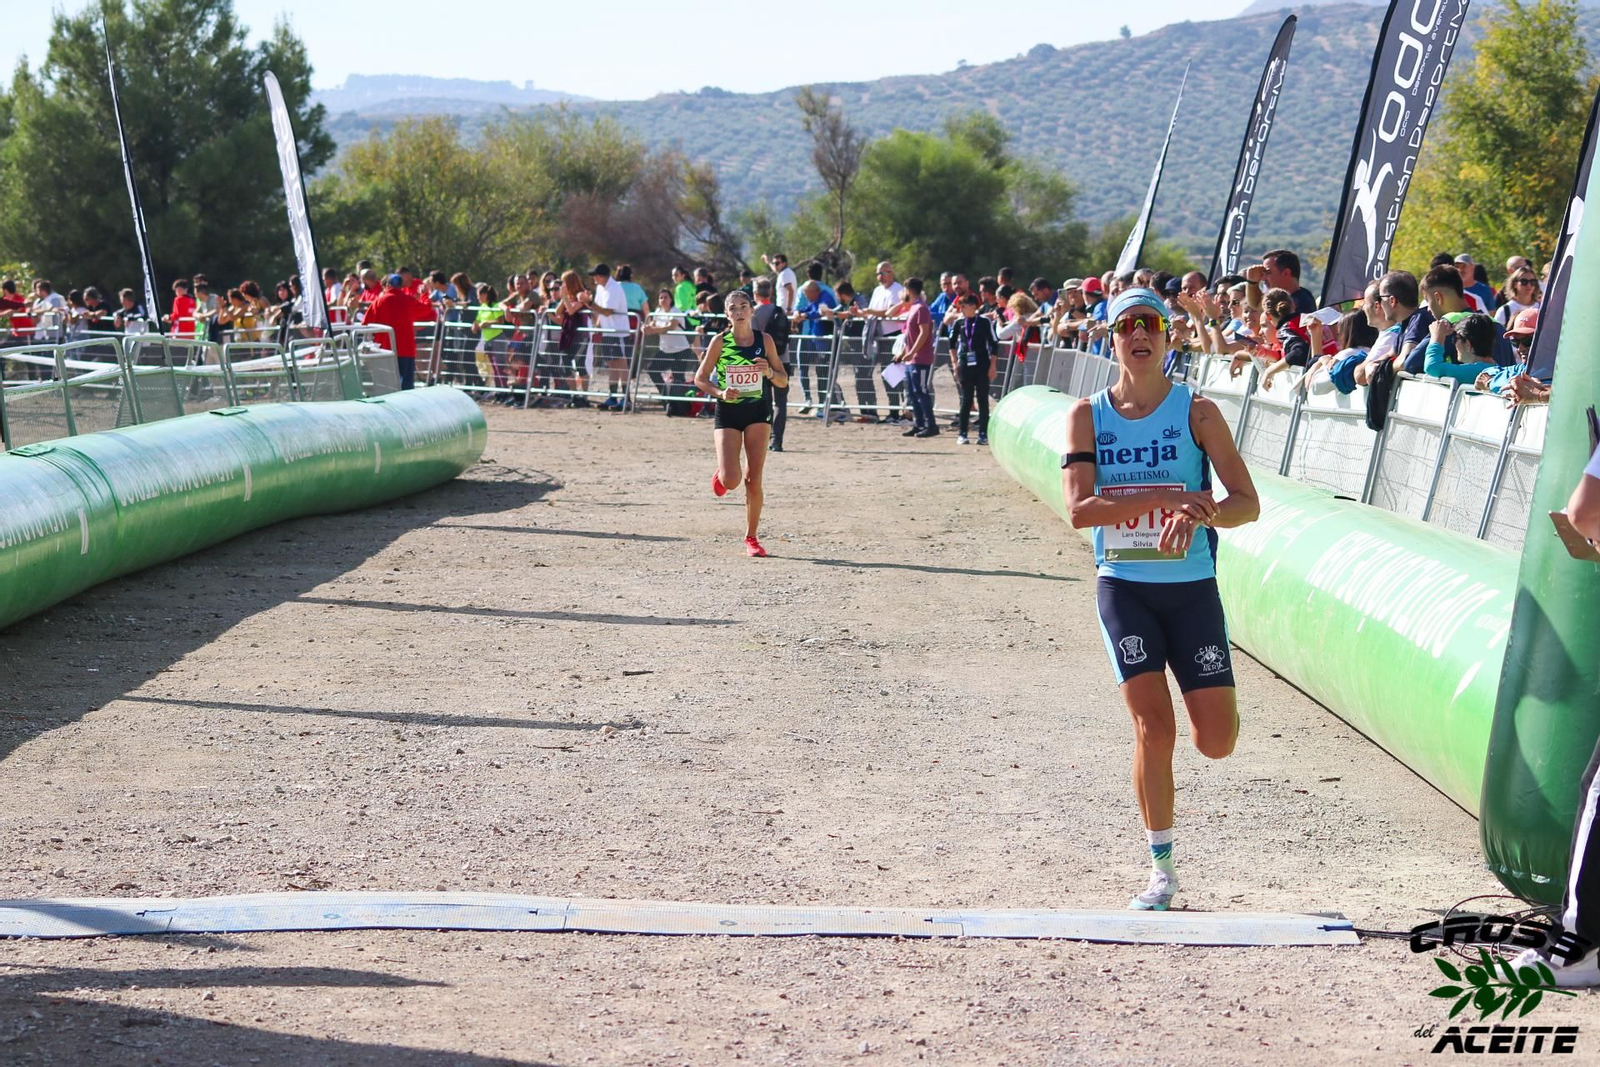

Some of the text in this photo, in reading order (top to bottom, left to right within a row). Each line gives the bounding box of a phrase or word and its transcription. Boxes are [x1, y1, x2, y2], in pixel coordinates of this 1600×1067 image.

[1373, 155, 1417, 280] Gestión
[729, 373, 759, 384] 1020
[1098, 439, 1178, 468] nerja
[1110, 469, 1170, 483] ATLETISMO
